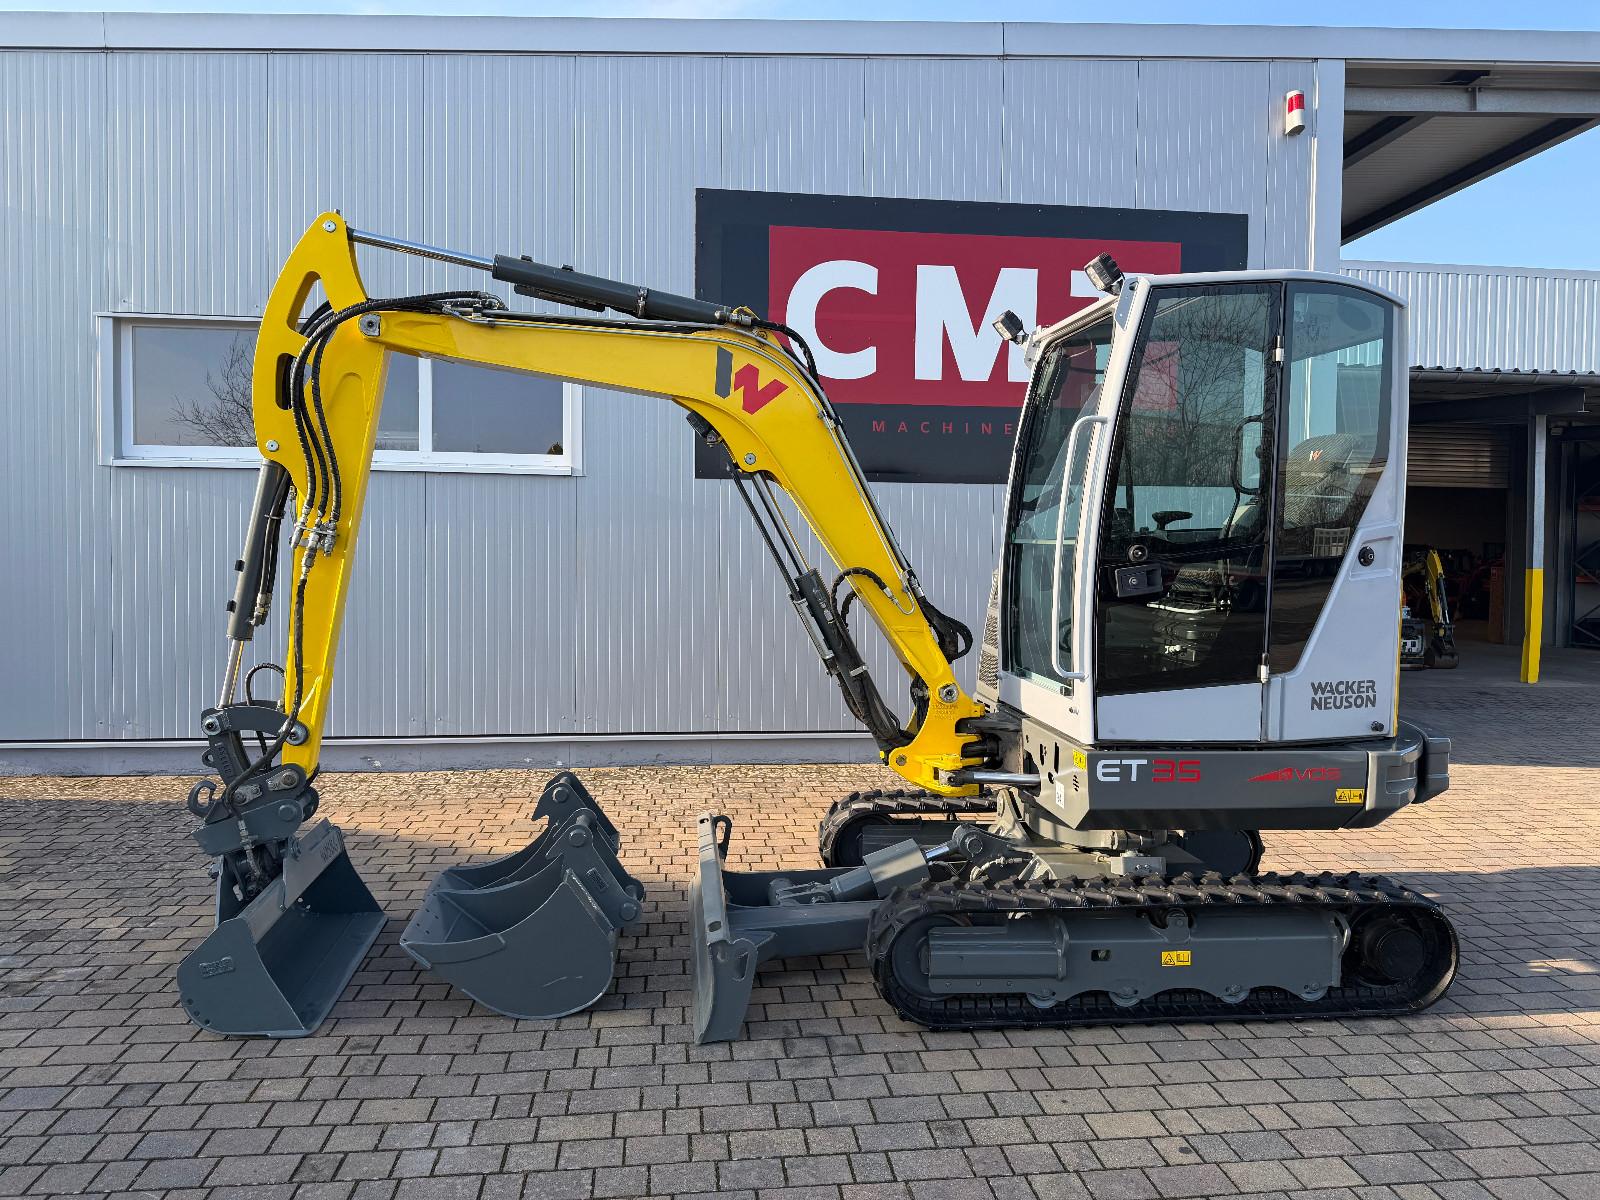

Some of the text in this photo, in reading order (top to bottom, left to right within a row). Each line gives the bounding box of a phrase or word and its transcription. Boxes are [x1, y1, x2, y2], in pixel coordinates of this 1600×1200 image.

[1310, 679, 1377, 695] WACKER
[1310, 694, 1377, 711] NEUSON
[1096, 758, 1201, 783] ET 35
